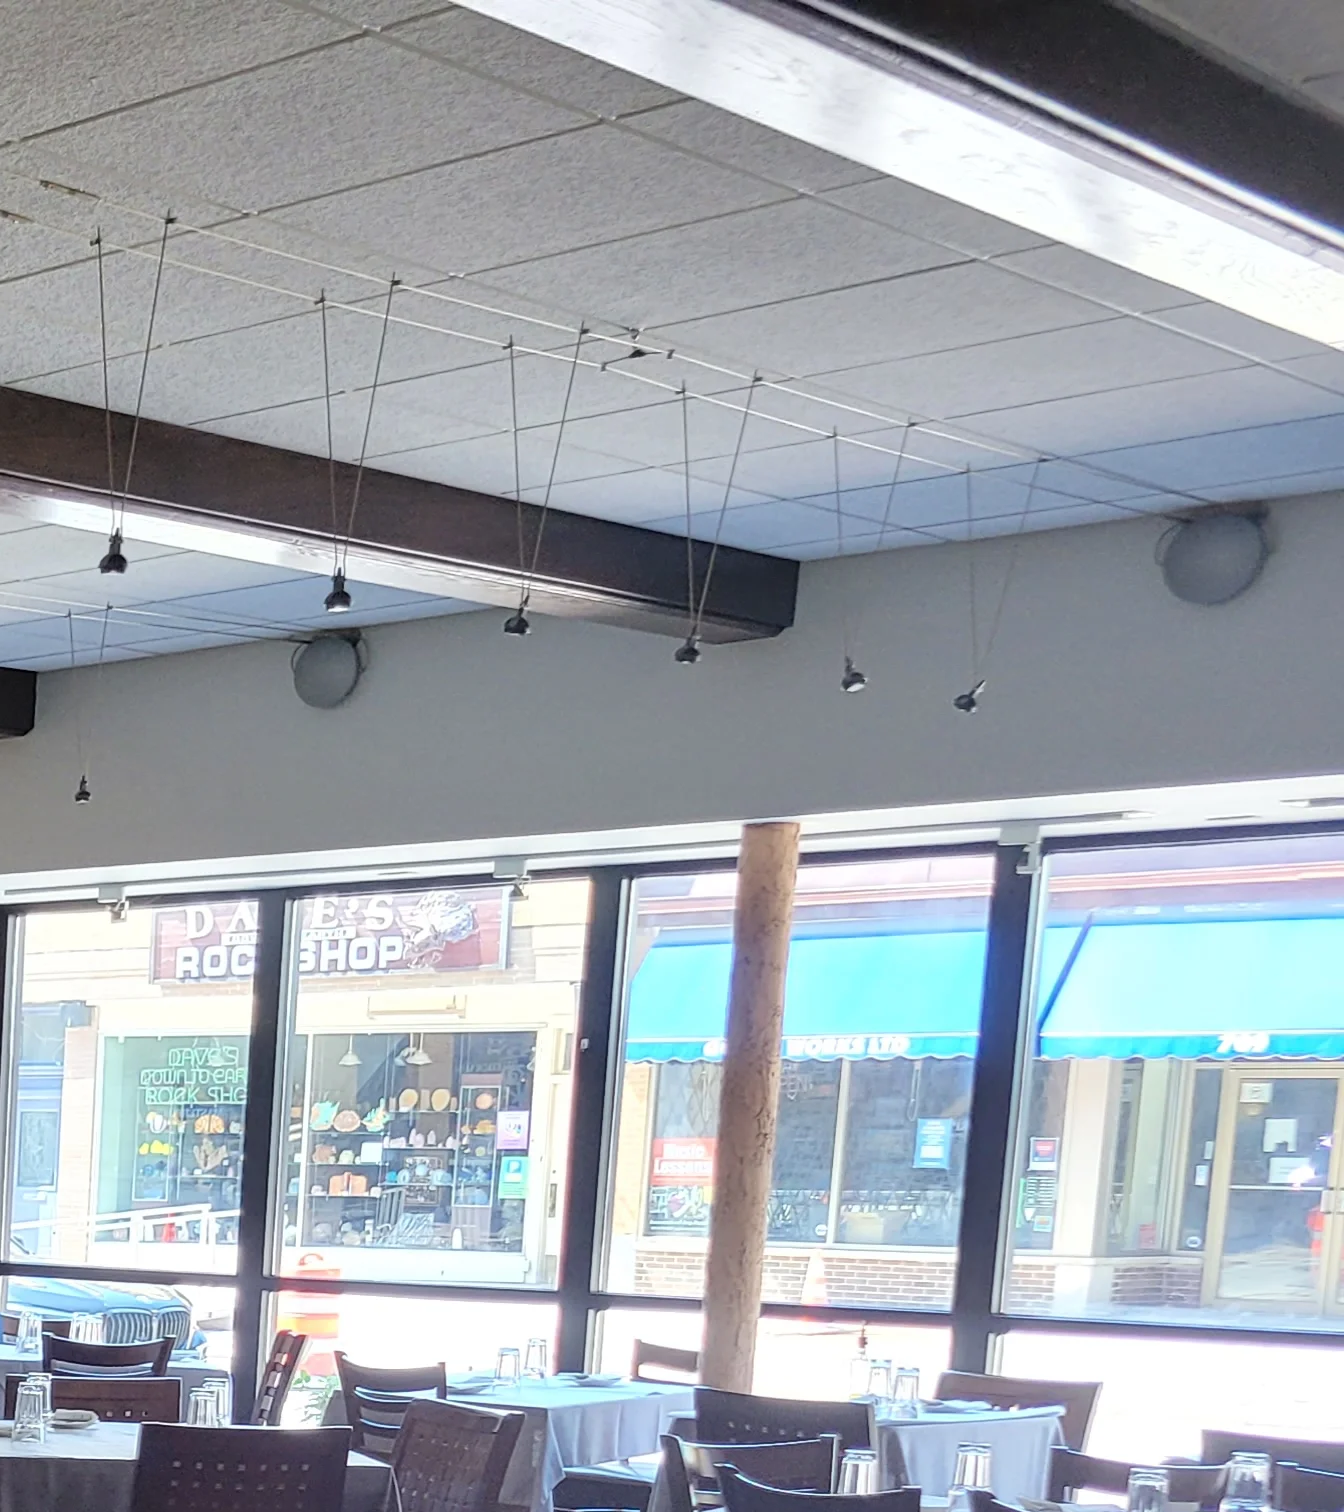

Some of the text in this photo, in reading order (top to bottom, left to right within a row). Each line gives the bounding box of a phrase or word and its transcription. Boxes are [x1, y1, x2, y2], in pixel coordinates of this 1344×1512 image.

[176, 936, 403, 978] ROC SHOP
[212, 1067, 247, 1085] EAR
[145, 1086, 248, 1105] ROCK SHO
